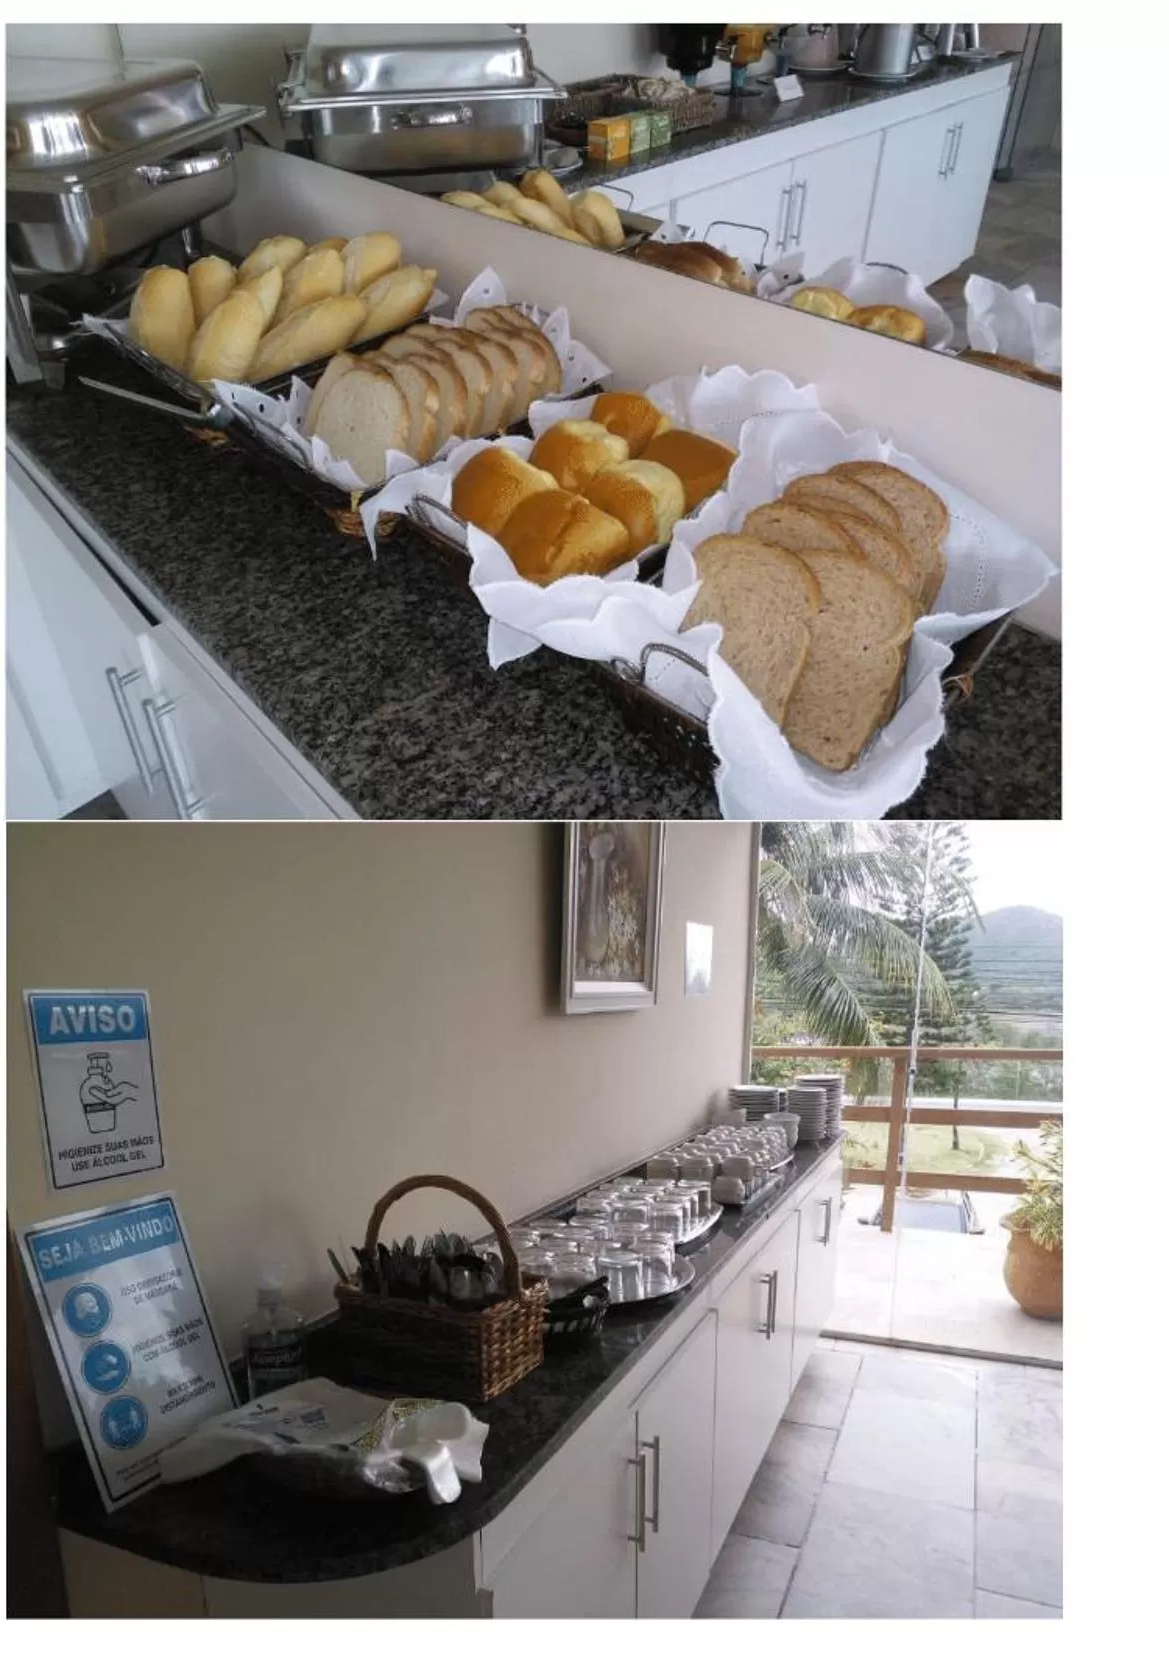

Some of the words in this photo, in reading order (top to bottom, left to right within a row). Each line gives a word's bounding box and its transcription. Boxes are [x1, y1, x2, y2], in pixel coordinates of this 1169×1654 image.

[49, 1004, 136, 1036] AVISO
[105, 1139, 129, 1152] SUAS
[71, 1159, 90, 1172] USE
[38, 1238, 83, 1270] SEJA
[88, 1215, 175, 1255] BEM-VINDO
